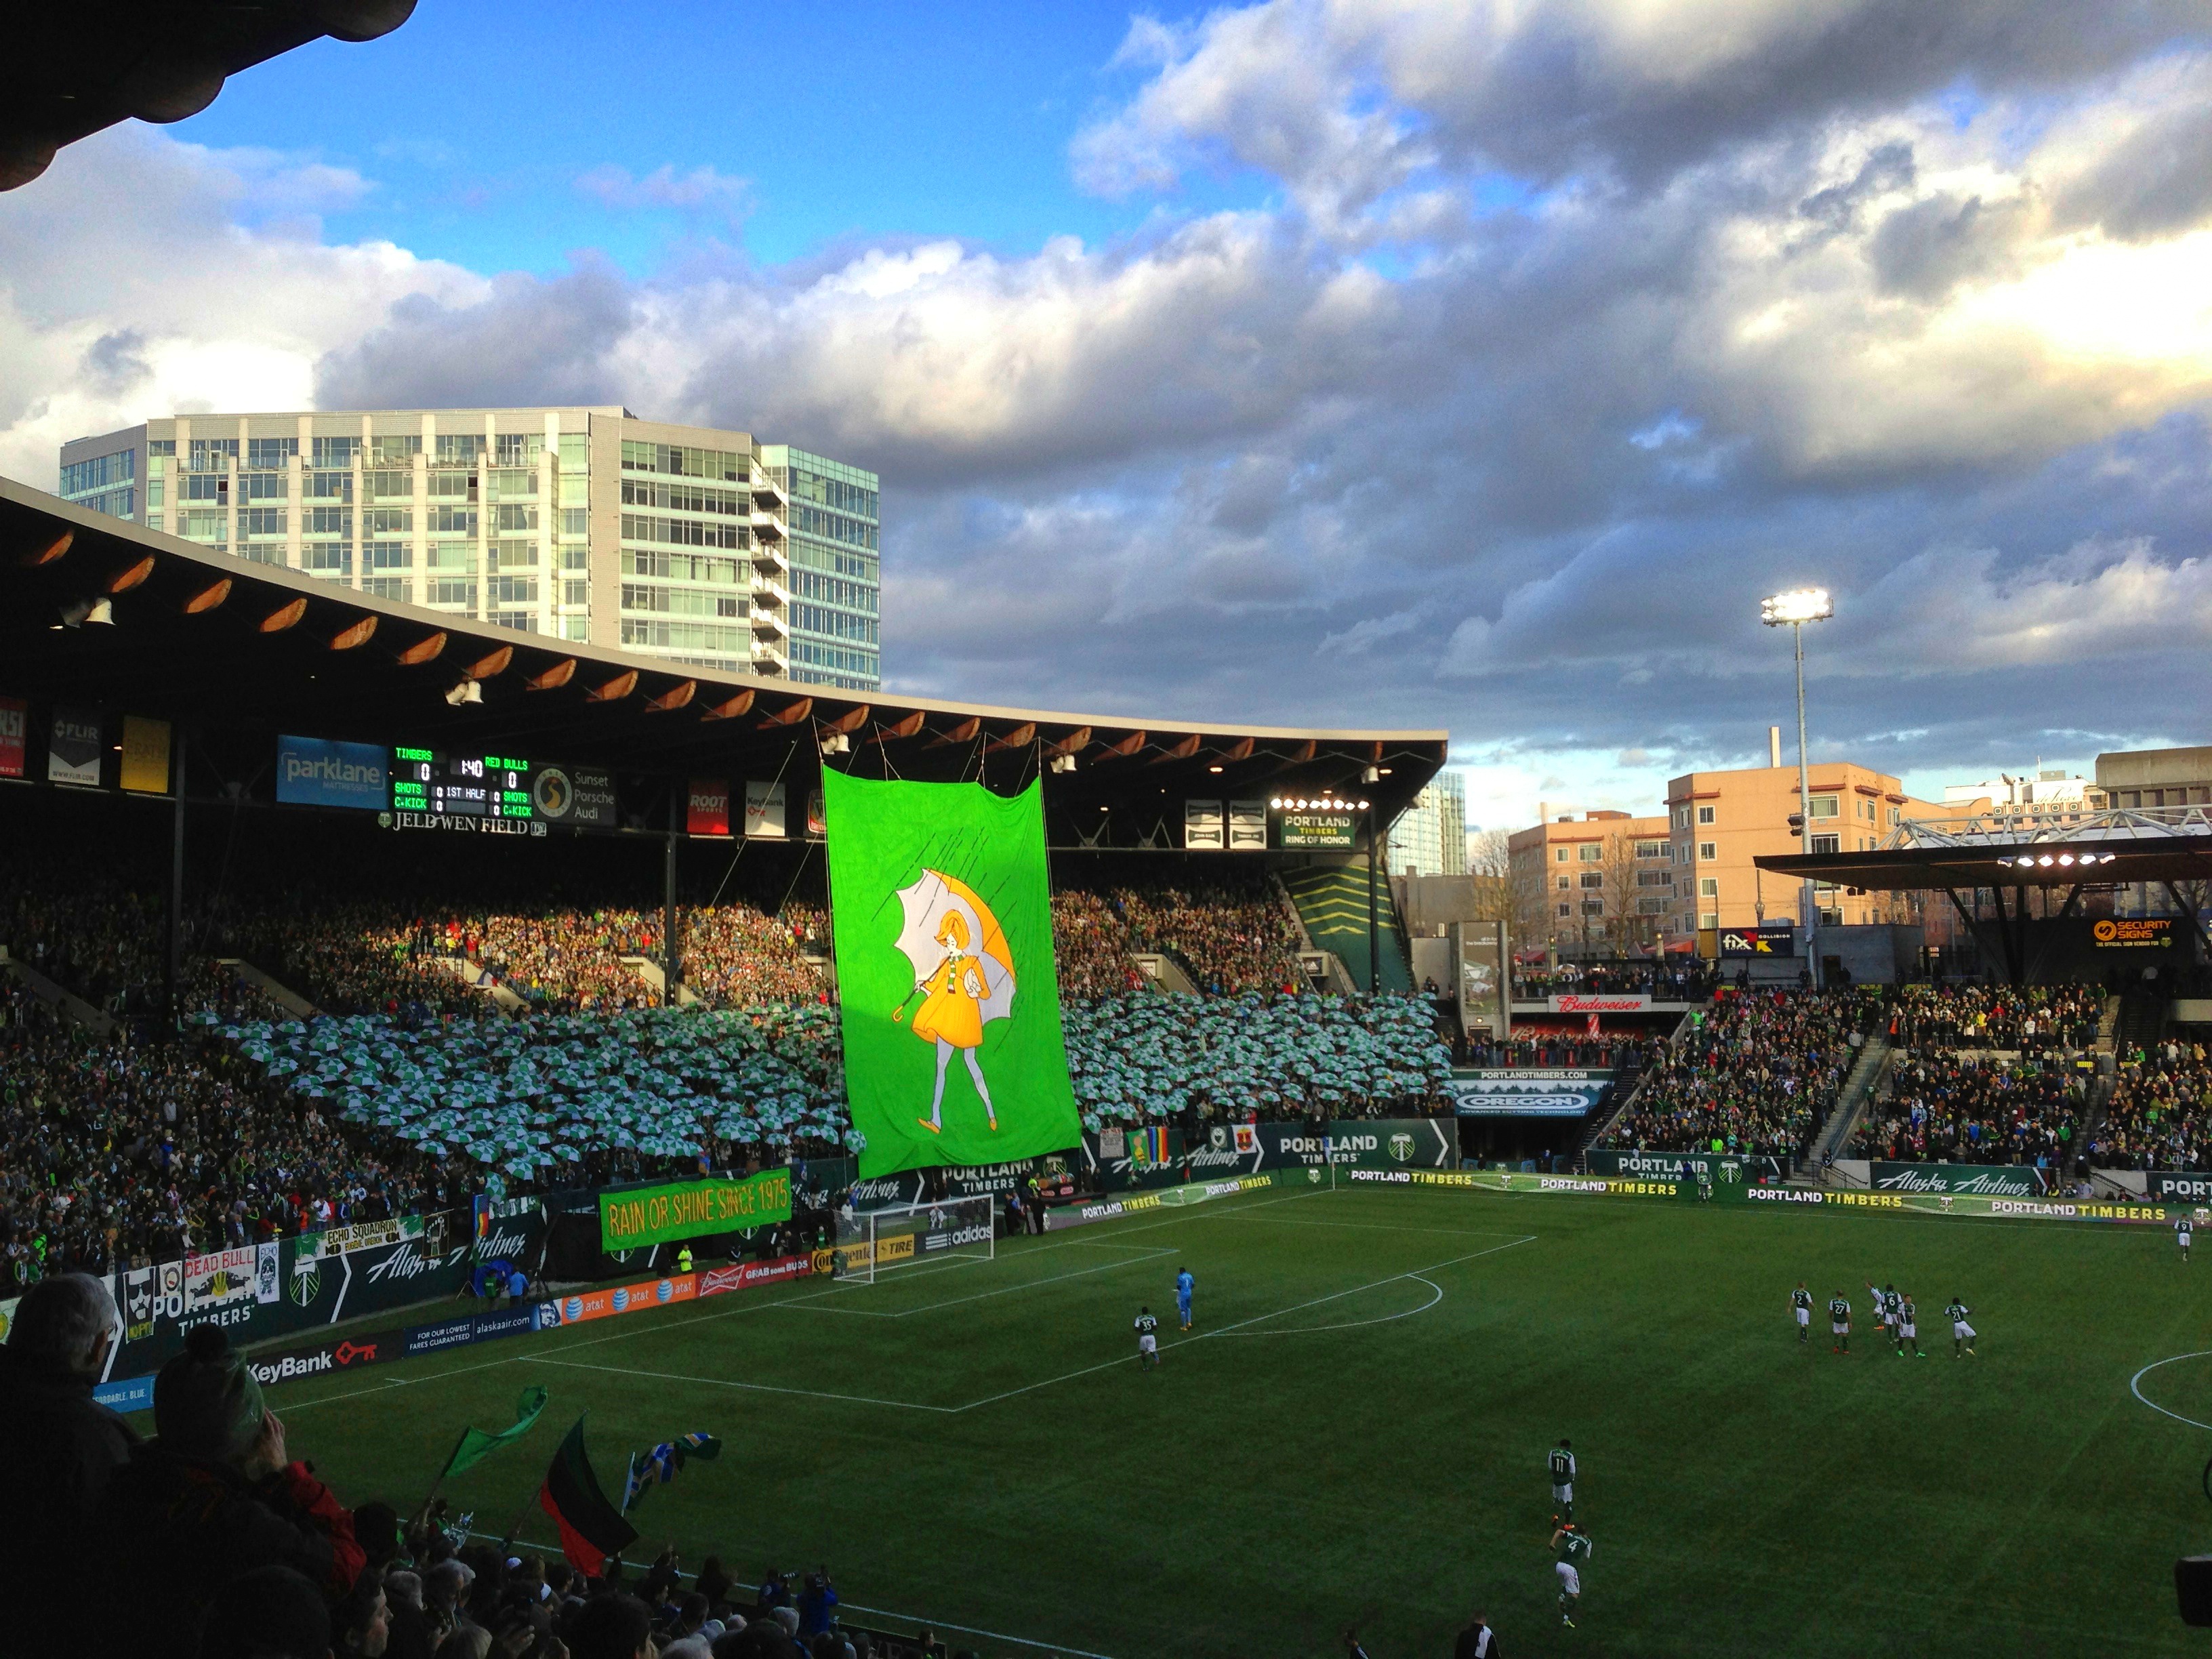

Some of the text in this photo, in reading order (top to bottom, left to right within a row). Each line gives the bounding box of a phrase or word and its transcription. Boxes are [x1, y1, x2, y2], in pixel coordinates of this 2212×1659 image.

[66, 722, 98, 740] FLIR
[396, 747, 433, 760] TIMBERS
[287, 756, 380, 783] parklane
[462, 760, 483, 777] 1:40
[485, 756, 528, 770] RED BULLS
[421, 763, 430, 781] 0
[508, 771, 516, 788] 0
[575, 772, 609, 787] Sunset
[323, 781, 368, 792] MATTRESSES
[395, 782, 443, 798] SHOTS 0
[447, 786, 486, 798] 1ST HALF
[394, 796, 443, 812] C.KICK 0
[494, 792, 527, 802] 0 SHOTS
[575, 789, 614, 804] Porsche
[689, 794, 727, 808] ROOT
[747, 797, 783, 806] KeyBank
[493, 804, 532, 817] 0 C.KICK
[575, 805, 598, 819] Audi
[480, 817, 528, 834] FIELD
[1285, 817, 1351, 827] PORTLAND
[1320, 836, 1351, 844] HONOR
[2117, 920, 2171, 929] SECURITY
[1723, 934, 1753, 950] fix
[2117, 930, 2153, 939] SIGNS
[1557, 996, 1642, 1012] Budweiser
[1481, 1071, 1587, 1080] PORTLANDTIMBERS.COM
[1470, 1097, 1572, 1105] OREGON
[1280, 1135, 1378, 1153] PORTLAND
[1300, 1153, 1357, 1164] TIMERS
[1618, 1158, 1708, 1173] PORTLAND
[942, 1159, 1033, 1181] PORTLAND
[1352, 1170, 1472, 1185] PORTLAND TIMBERS
[962, 1178, 1015, 1193] TIMBERS
[1205, 1175, 1272, 1195] PORTLAND TIMBERS
[1541, 1179, 1677, 1195] PORTLAND TIMBERS
[1877, 1170, 2029, 1195] Alaska Airlines
[1747, 1188, 1902, 1208] PORTLAND TIMBERS
[609, 1200, 645, 1236] RAIN
[649, 1195, 669, 1229] OR
[673, 1189, 714, 1225] SHINE
[718, 1183, 755, 1218] SINCE
[758, 1177, 787, 1210] 1975
[1082, 1195, 1161, 1219] PORTLAND TIMBERS
[1991, 1201, 2167, 1221] PORTLAND TIMBERS
[328, 1220, 397, 1244] ECHO SQUADRON
[951, 1225, 991, 1246] adidas
[889, 1240, 912, 1255] TIRE
[185, 1250, 254, 1278] DEAD BULL
[701, 1273, 742, 1288] Budweiser
[745, 1267, 770, 1279] GRAB
[785, 1259, 808, 1271] BUDS
[675, 1281, 692, 1294] at&t
[630, 1290, 649, 1303] at&t
[1797, 1296, 1802, 1305] 2
[1889, 1297, 1895, 1306] 6
[586, 1298, 604, 1312] at&t
[1835, 1305, 1845, 1314] 27
[1952, 1311, 1961, 1321] 21
[417, 1315, 529, 1340] FOR OUR LOWEST alaskaair.com
[409, 1332, 470, 1351] FARES GUARANTEED
[246, 1351, 333, 1385] KeyBank
[1556, 1458, 1563, 1472] 11
[1568, 1540, 1579, 1553] 4
